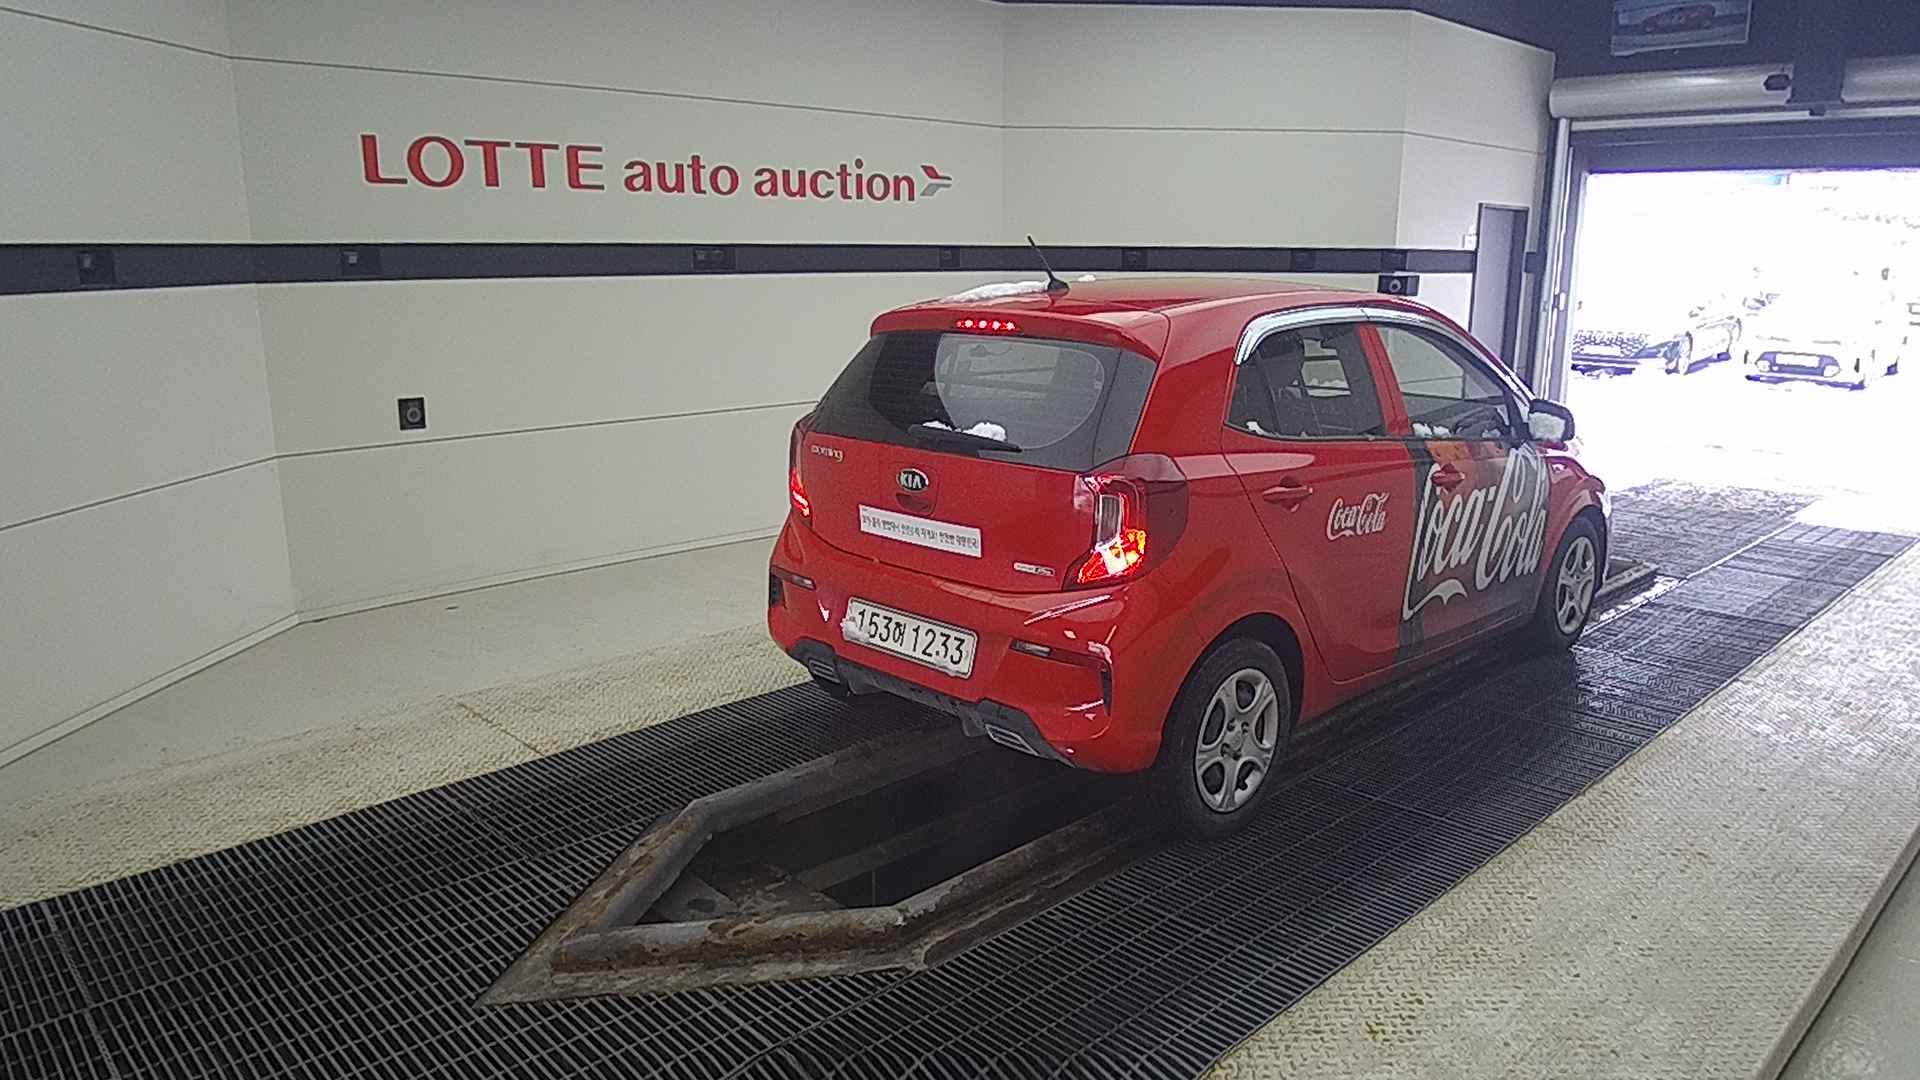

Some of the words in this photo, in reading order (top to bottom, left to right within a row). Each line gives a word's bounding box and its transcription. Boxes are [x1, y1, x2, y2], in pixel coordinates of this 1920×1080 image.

[360, 134, 606, 190] LOTTE
[623, 154, 740, 196] auto
[753, 158, 916, 201] auction
[900, 470, 923, 490] KIA
[912, 624, 965, 665] 1233
